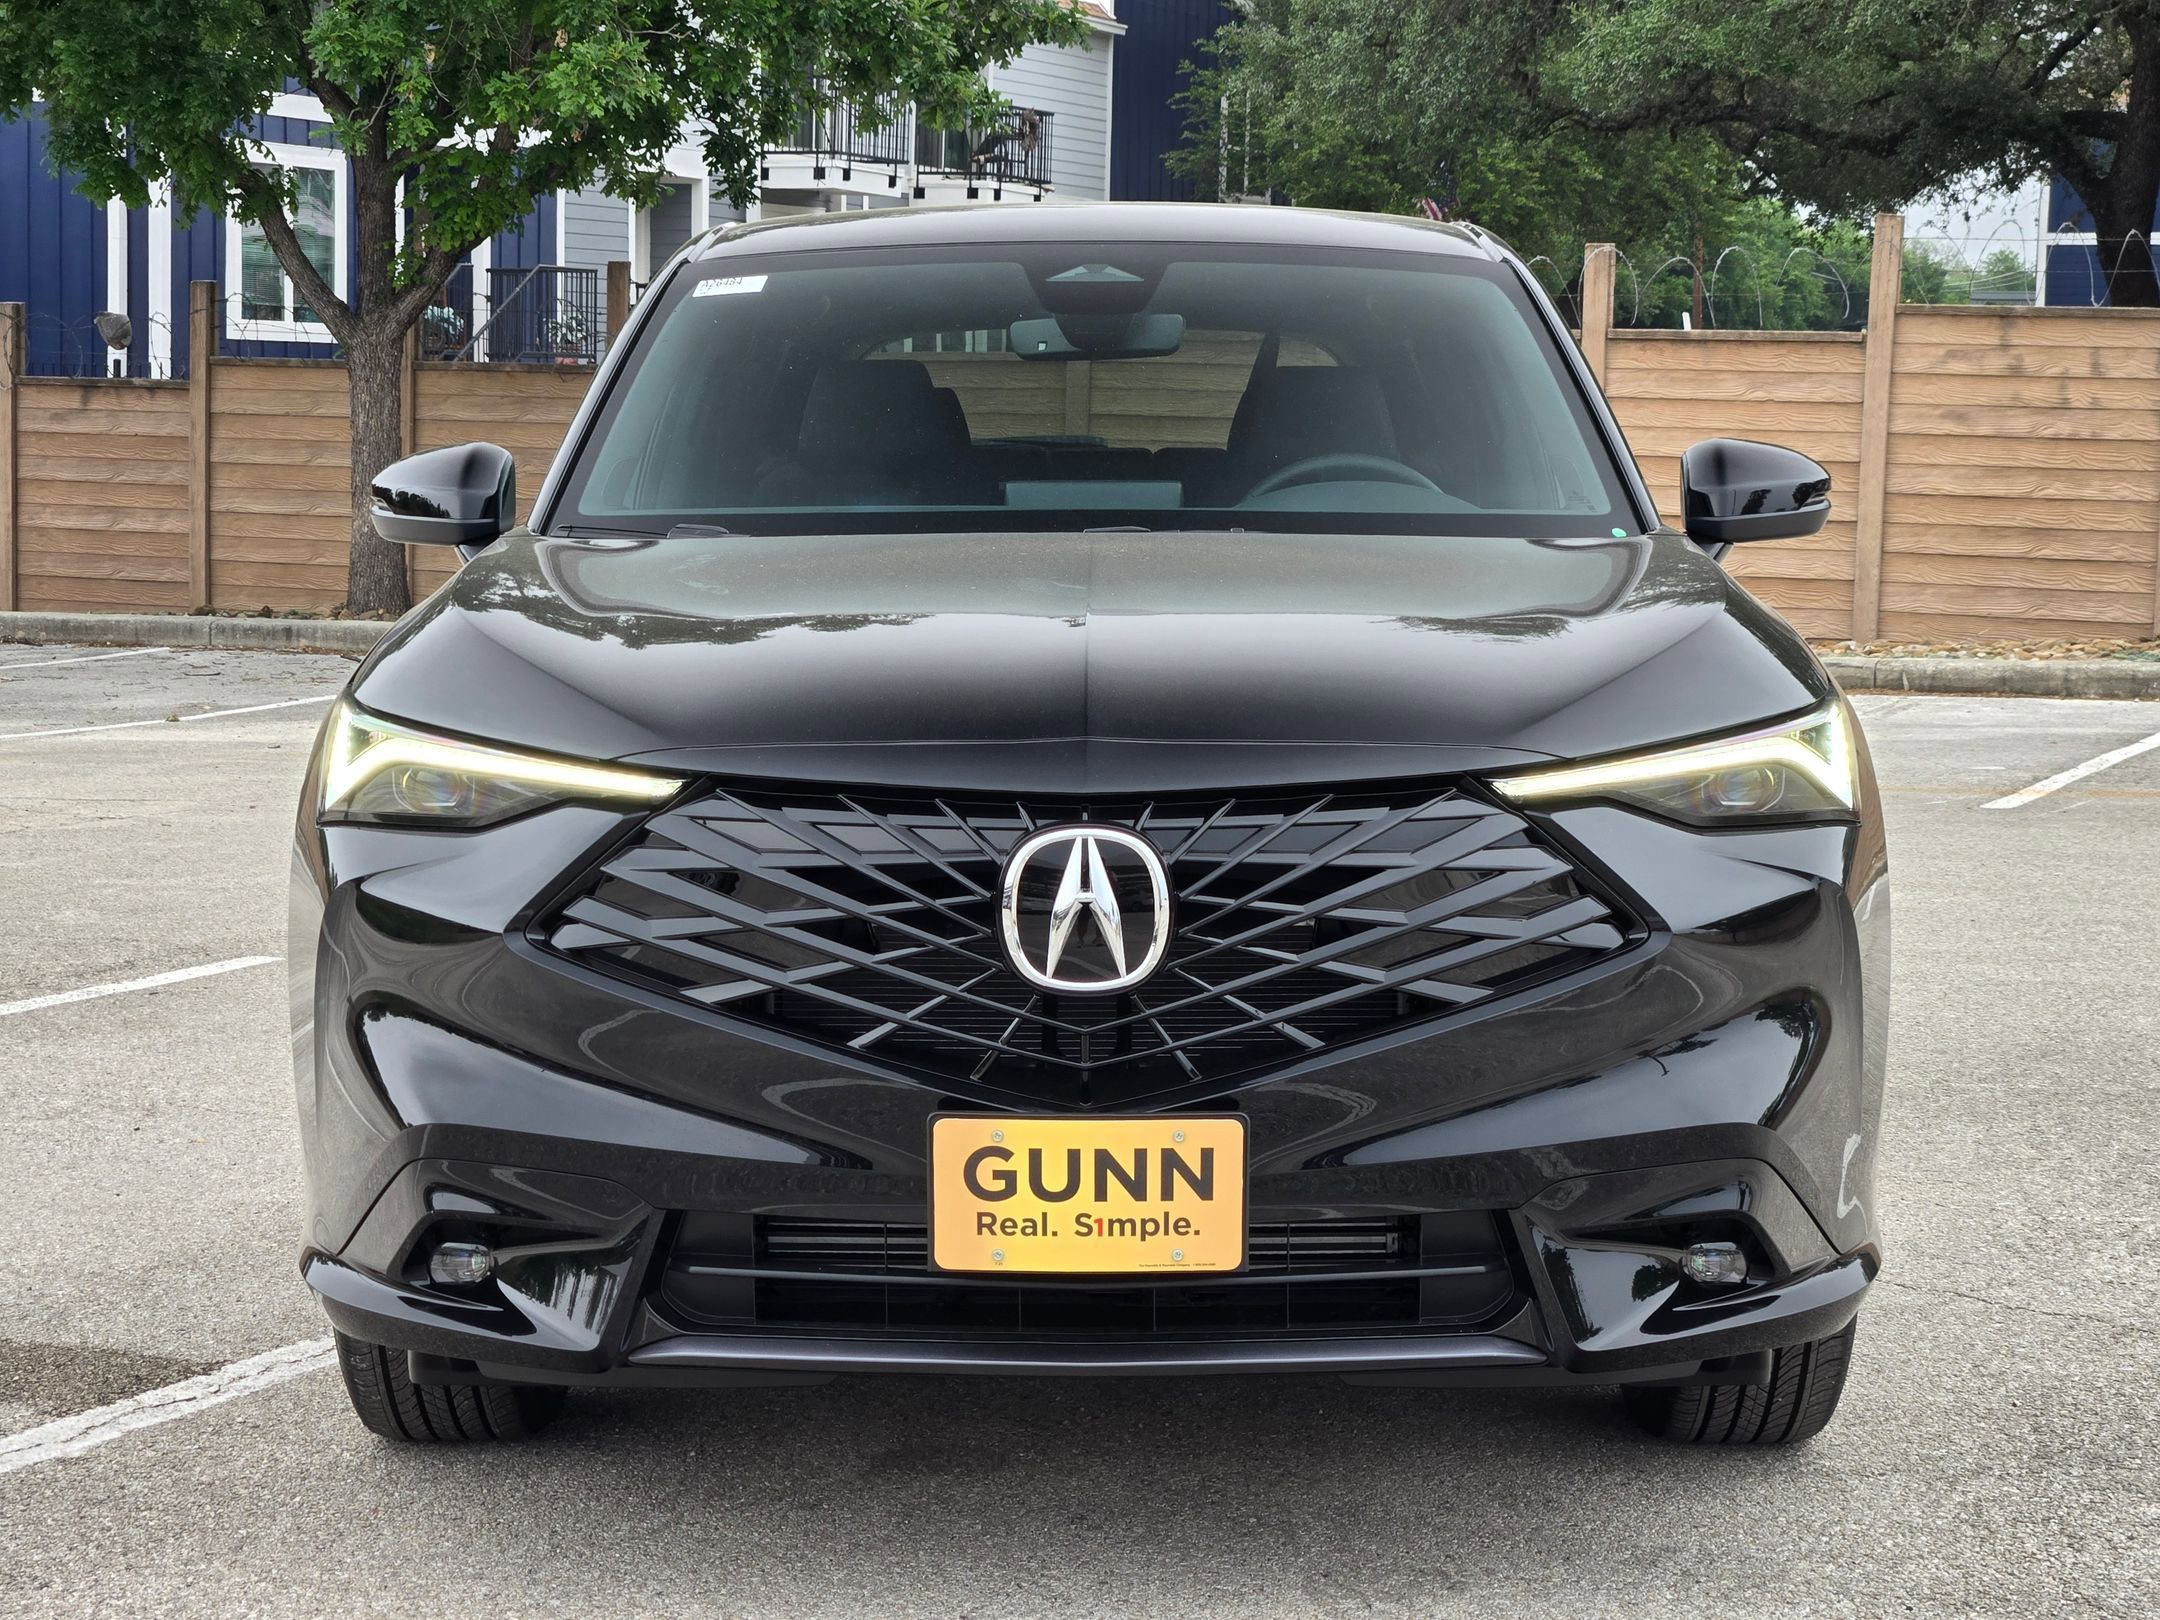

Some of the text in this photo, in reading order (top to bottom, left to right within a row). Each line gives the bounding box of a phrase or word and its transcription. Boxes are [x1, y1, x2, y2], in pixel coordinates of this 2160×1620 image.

[963, 1145, 1214, 1203] GUNN
[976, 1211, 1201, 1242] Real. S1mple.
